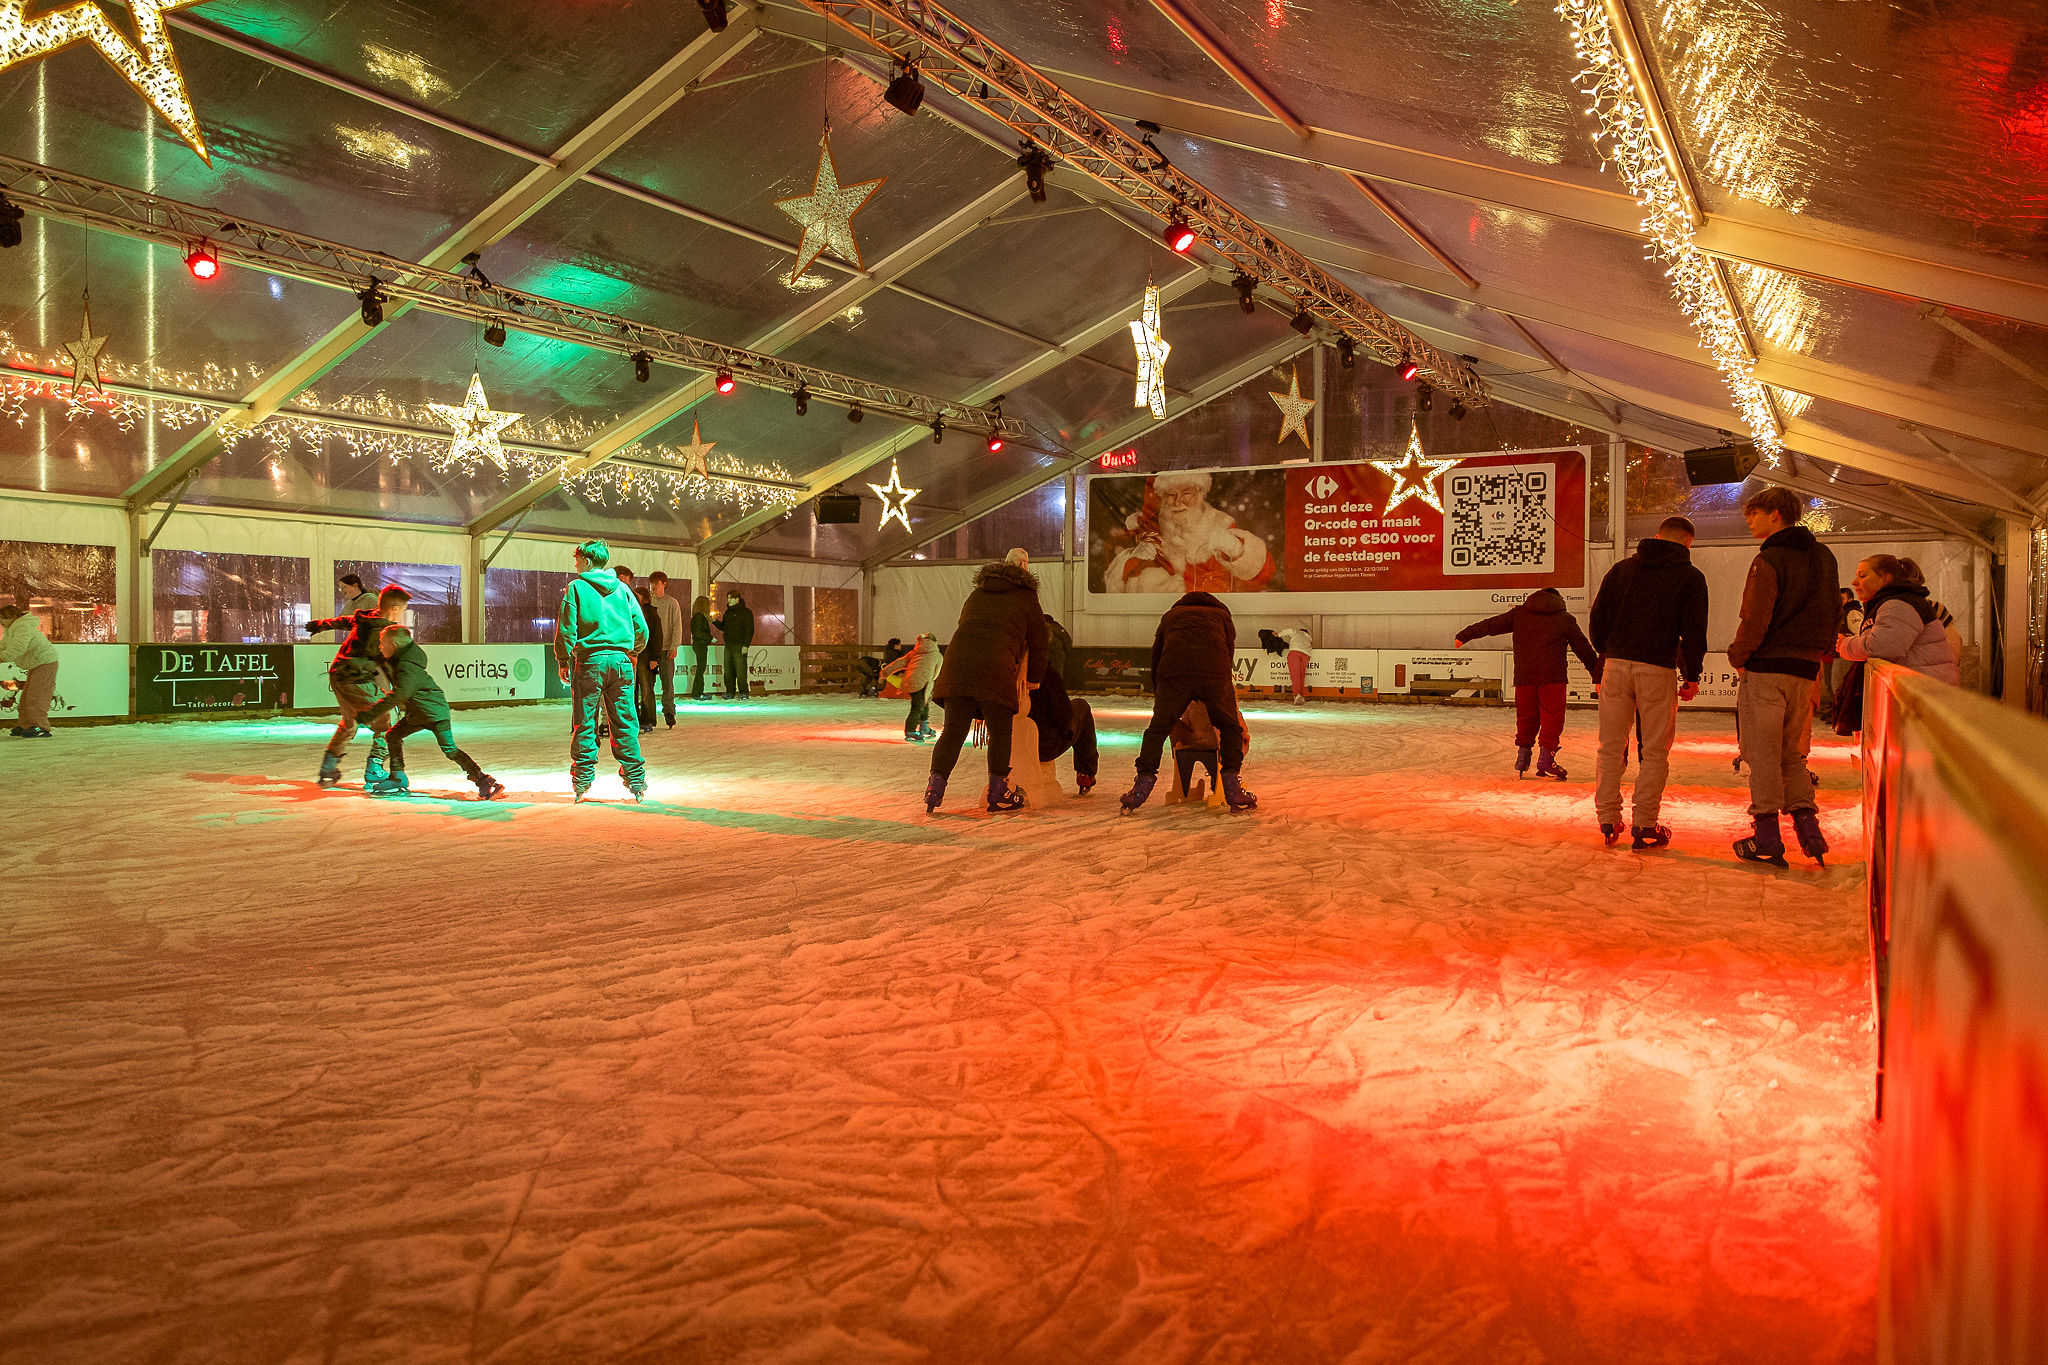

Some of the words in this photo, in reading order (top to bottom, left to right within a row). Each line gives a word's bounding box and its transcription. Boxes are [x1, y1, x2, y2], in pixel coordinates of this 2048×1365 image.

[1304, 503, 1337, 514] Scan
[1340, 502, 1373, 513] deze
[1304, 518, 1358, 530] Qr-code
[1360, 519, 1378, 528] en
[1382, 515, 1421, 528] maak
[1304, 536, 1336, 546] kans
[1339, 536, 1357, 548] op
[1360, 532, 1400, 545] €500
[1402, 534, 1436, 543] voor
[1303, 551, 1321, 563] de
[1323, 550, 1401, 563] feestdagen
[1491, 592, 1528, 603] Carref
[443, 659, 508, 679] veritas
[1270, 661, 1288, 669] DOV
[1717, 689, 1737, 697] 3300
